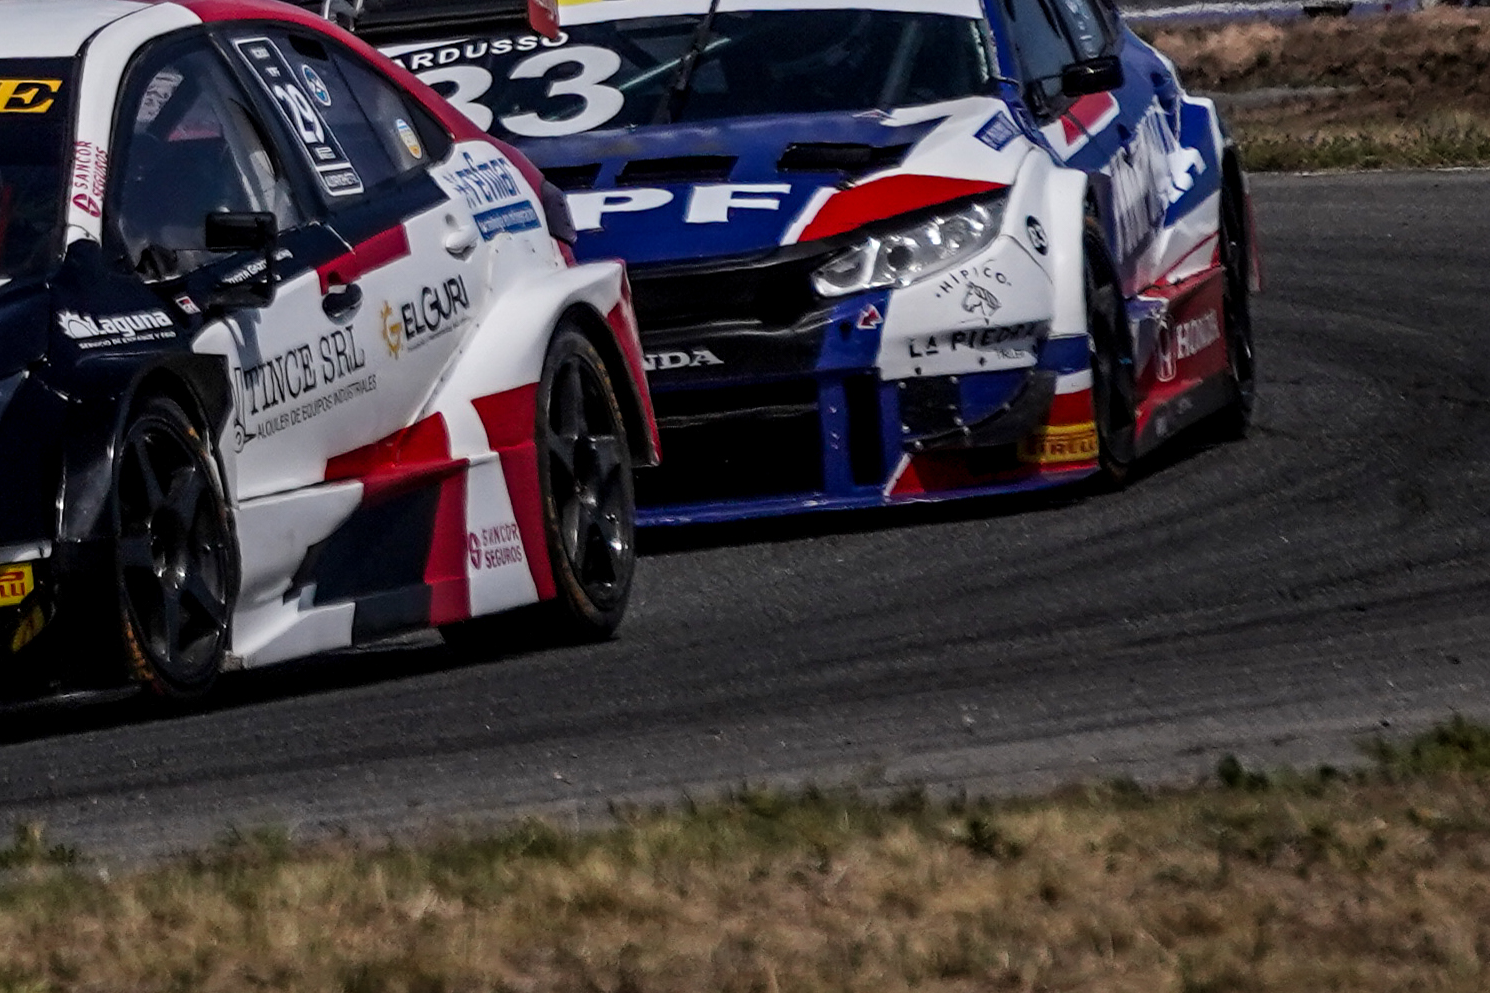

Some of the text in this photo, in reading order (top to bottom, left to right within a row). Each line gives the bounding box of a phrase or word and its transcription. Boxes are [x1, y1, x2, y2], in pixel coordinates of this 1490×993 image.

[73, 140, 92, 190] SANCOR
[566, 183, 792, 231] PF
[83, 310, 174, 337] Laguna
[319, 324, 365, 385] SRL
[642, 350, 725, 372] NDA
[290, 407, 302, 426] DE
[482, 523, 520, 547] SANCOR
[485, 546, 523, 569] SEGUROS
